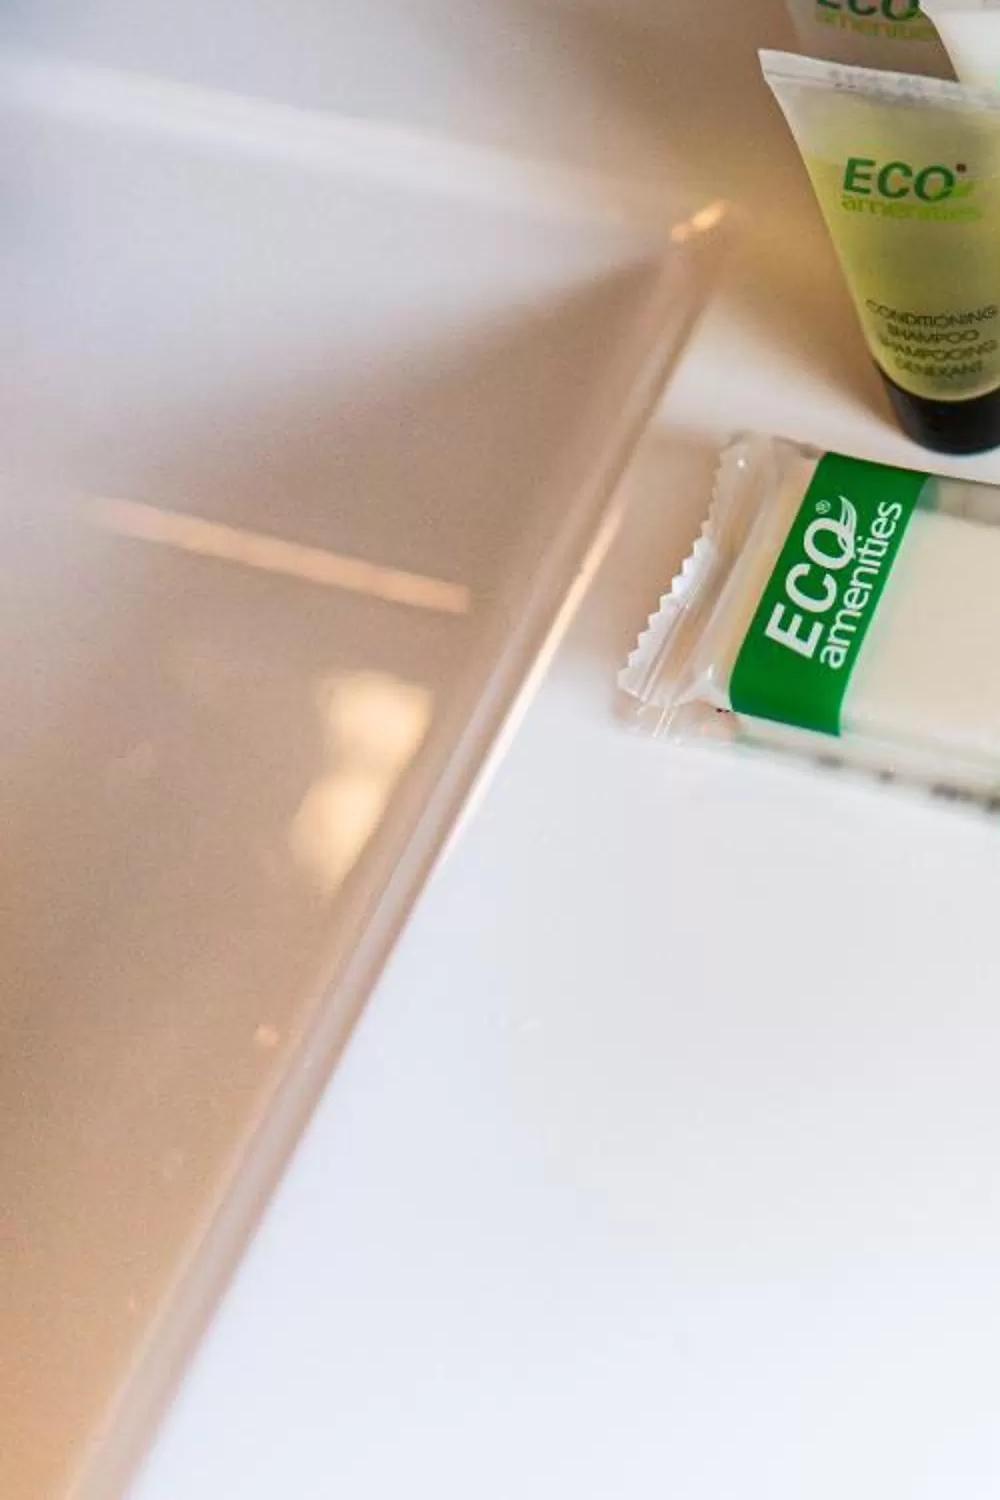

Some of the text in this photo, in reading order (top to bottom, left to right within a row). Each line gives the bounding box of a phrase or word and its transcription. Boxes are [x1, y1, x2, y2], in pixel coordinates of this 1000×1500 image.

[843, 156, 956, 203] ECO
[839, 194, 982, 222] amenities
[865, 299, 999, 328] CONDITIONING
[886, 322, 979, 344] SHAMPOO
[819, 501, 904, 670] amenities
